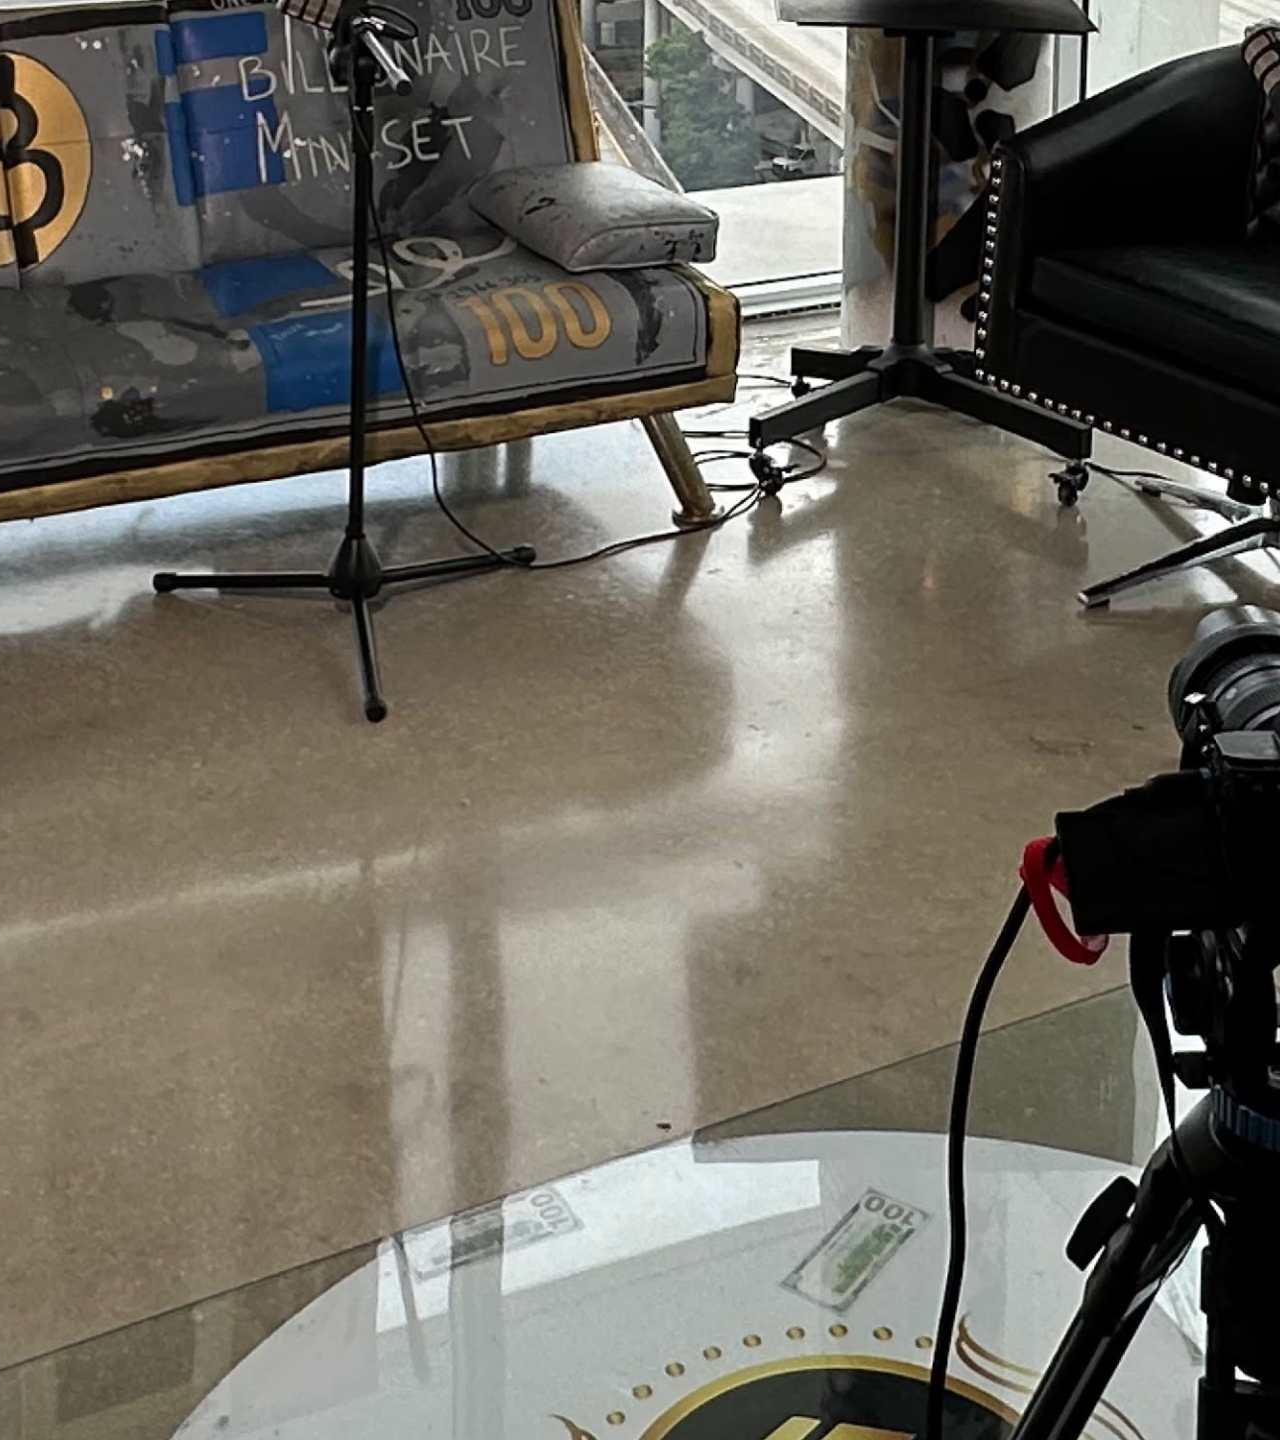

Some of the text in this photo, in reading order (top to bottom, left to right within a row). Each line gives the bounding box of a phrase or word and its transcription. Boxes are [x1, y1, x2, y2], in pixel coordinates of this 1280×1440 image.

[238, 15, 528, 102] BILLNAIRE
[255, 111, 475, 184] MINSET
[459, 279, 613, 367] 100
[530, 1193, 571, 1232] 100
[863, 1195, 916, 1227] 100
